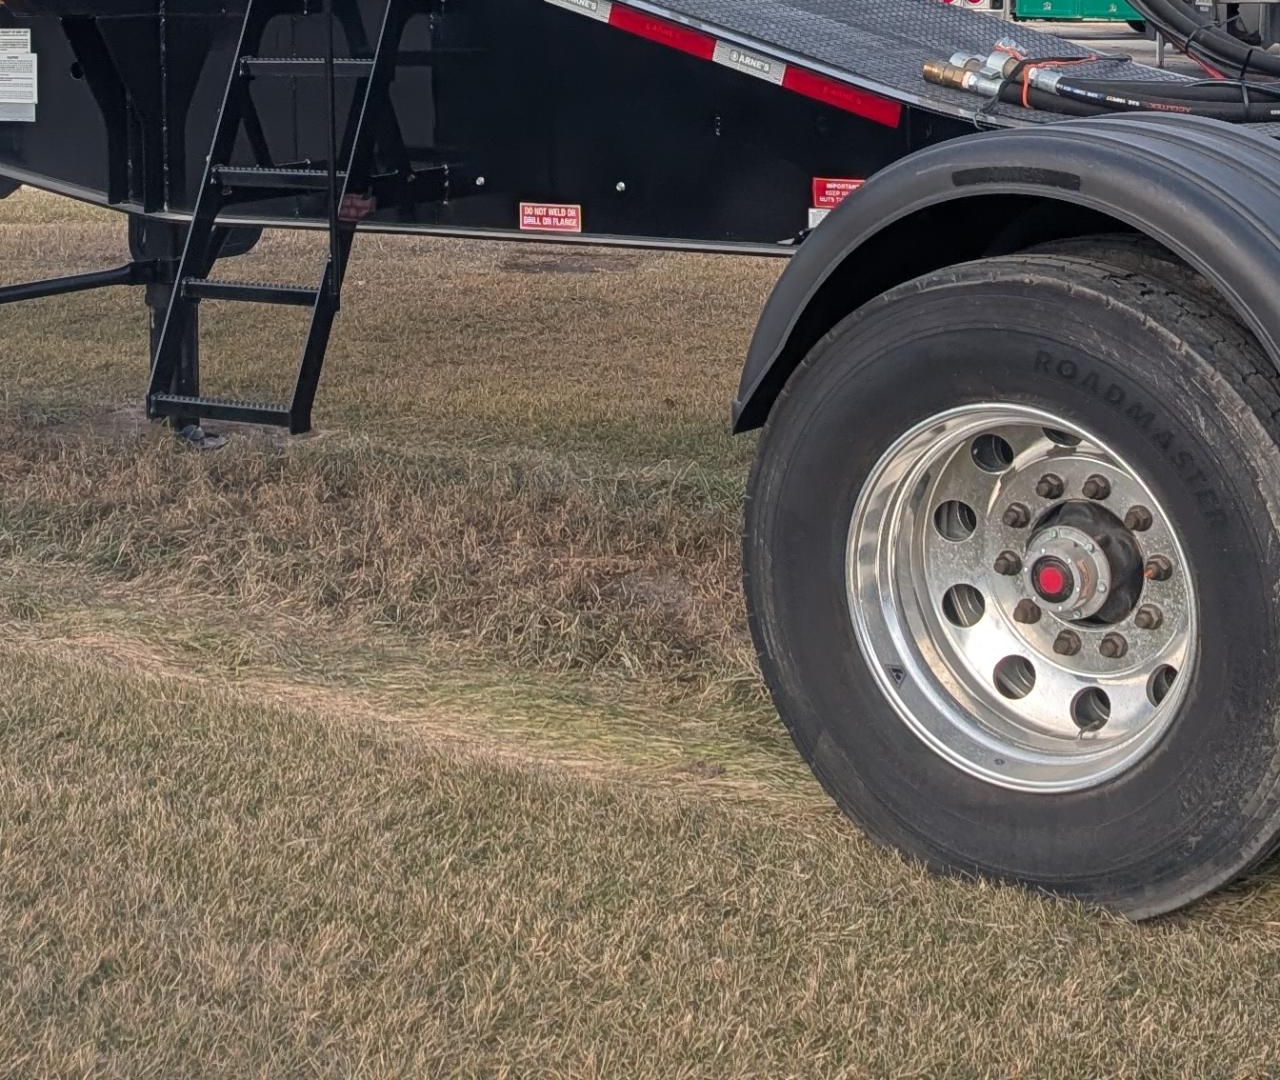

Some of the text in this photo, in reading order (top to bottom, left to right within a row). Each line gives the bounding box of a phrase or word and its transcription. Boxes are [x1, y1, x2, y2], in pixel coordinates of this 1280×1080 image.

[739, 54, 769, 71] ARNE'S
[524, 206, 533, 215] DO
[534, 207, 547, 216] NOT
[548, 208, 566, 216] WELD
[1033, 349, 1226, 528] ROADMASTER
